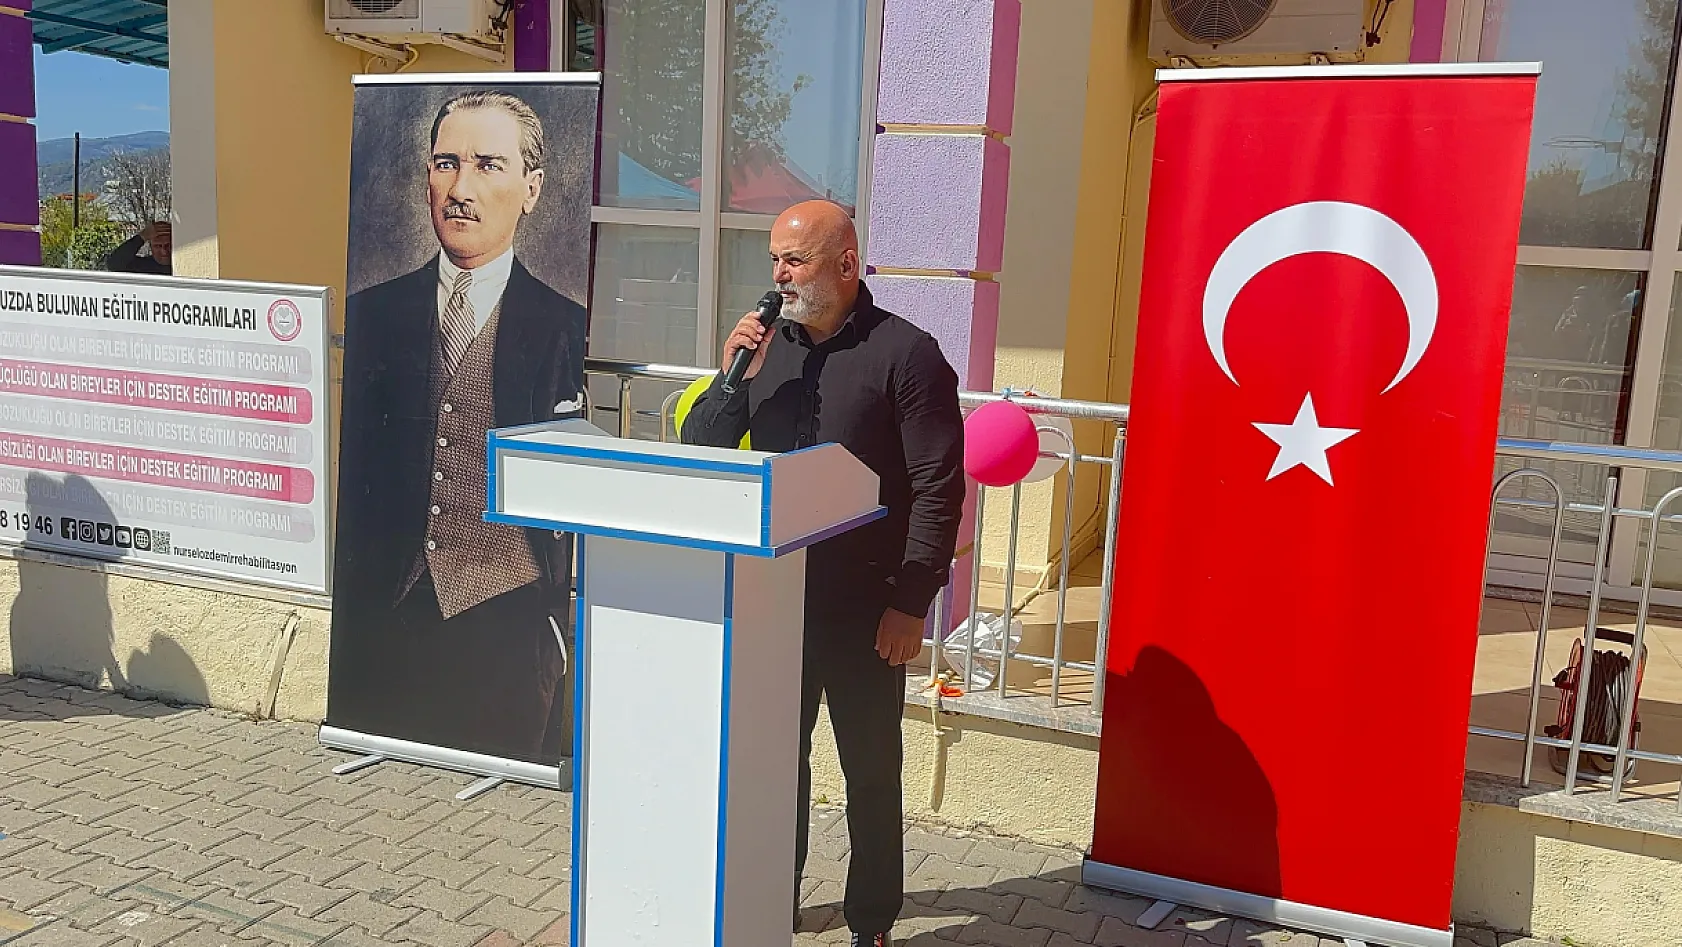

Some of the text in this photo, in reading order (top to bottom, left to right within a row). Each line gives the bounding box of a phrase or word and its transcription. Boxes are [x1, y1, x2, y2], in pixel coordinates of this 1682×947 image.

[0, 290, 34, 312] UZDA
[37, 292, 98, 317] BULUNAN
[102, 293, 149, 322] EĞİTİM
[153, 301, 257, 330] PROGRAMLARI
[50, 334, 76, 353] OLAN
[131, 337, 152, 365] İÇİN
[154, 343, 195, 364] DESTEK
[199, 344, 236, 368] EĞİTİM
[238, 351, 298, 374] PROGRAMI
[40, 370, 68, 390] OLAN
[70, 370, 121, 396] BİREYLER
[124, 375, 145, 402] İÇİN
[148, 383, 190, 403] DESTEK
[193, 382, 232, 407] EĞİTİM
[234, 390, 297, 414] PROGRAMI
[55, 409, 81, 429] OLAN
[84, 410, 131, 435] BİREYLER
[133, 414, 154, 440] İÇİN
[157, 421, 197, 443] DESTEK
[200, 423, 236, 447] EĞİTİM
[238, 430, 297, 454] PROGRAMI
[38, 445, 65, 464] OLAN
[67, 445, 115, 470] BİREYLER
[117, 449, 138, 477] İÇİN
[140, 457, 181, 479] DESTEK
[183, 459, 221, 484] EĞİTİM
[223, 467, 283, 492] PROGRAMI
[0, 510, 53, 536] 8 19 46
[122, 489, 144, 515] İÇİN
[146, 496, 187, 518] DESTEK
[190, 499, 227, 523] EĞİTİM
[230, 508, 291, 532] PROGRAMI
[173, 546, 298, 574] nurselozdemirrehabilitasyon
